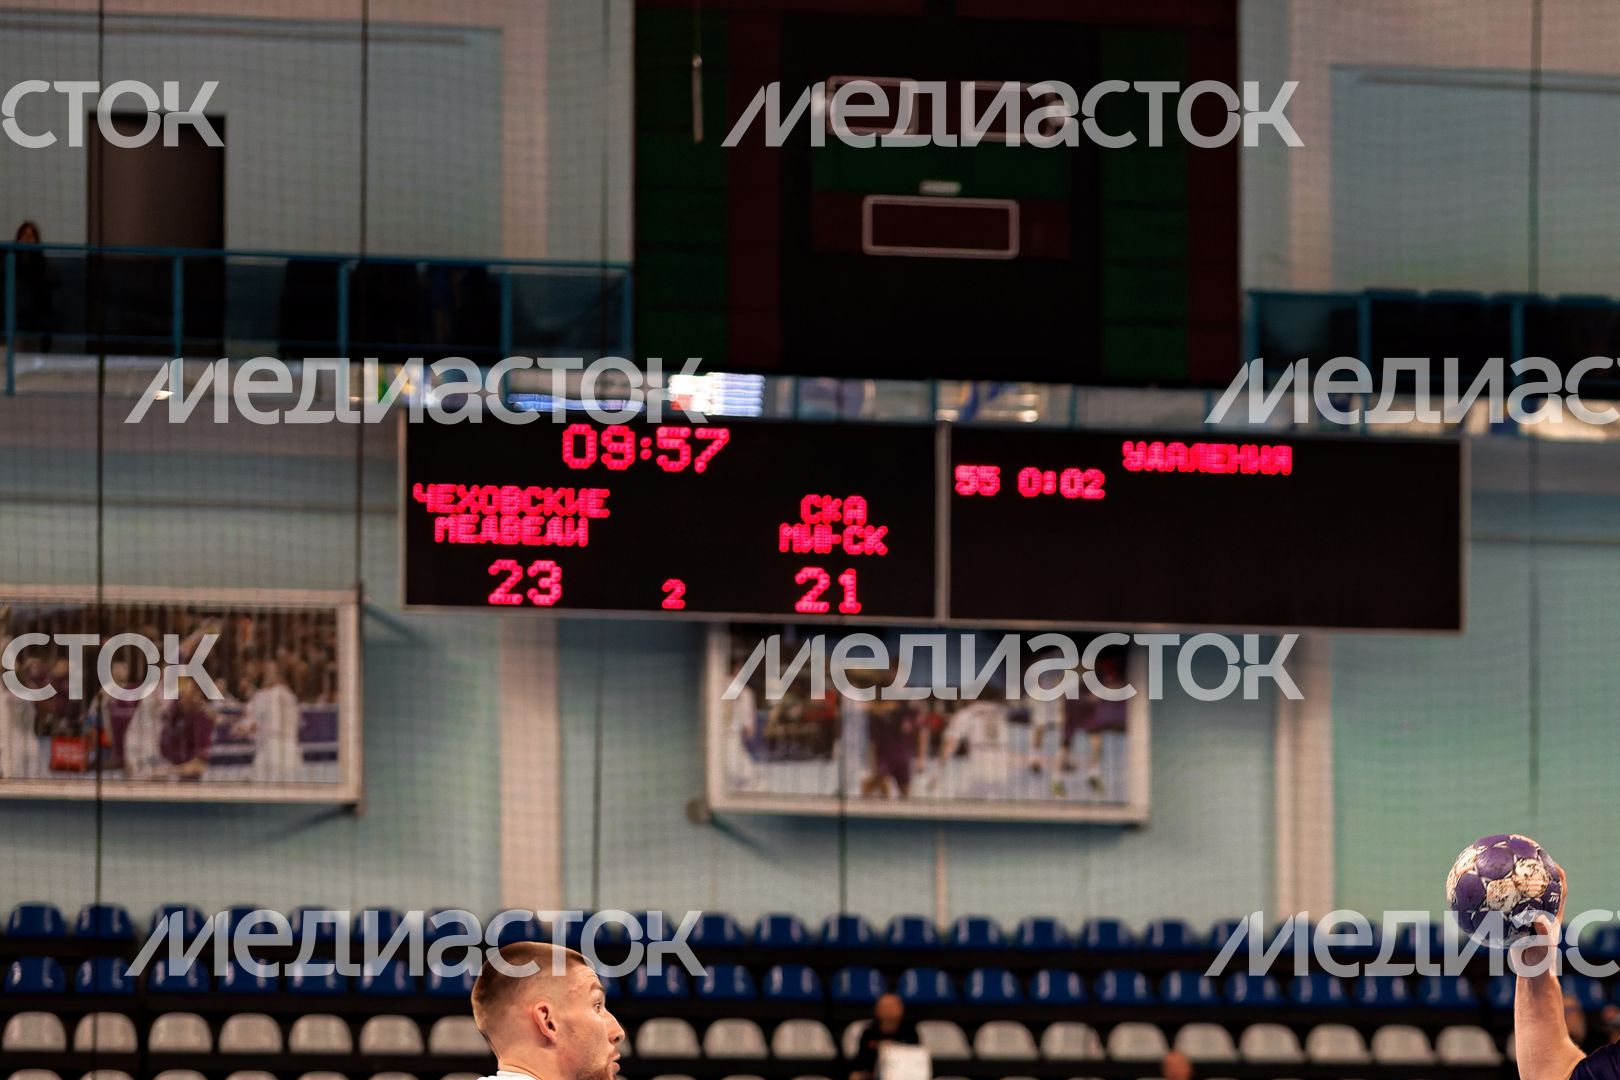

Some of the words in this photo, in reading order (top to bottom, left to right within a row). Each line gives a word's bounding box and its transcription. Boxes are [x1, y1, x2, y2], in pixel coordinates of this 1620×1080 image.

[562, 423, 730, 472] 09:57
[955, 465, 1000, 496] 55
[1018, 467, 1105, 499] 0:02
[412, 483, 610, 518] ЧЕХОВСКИЕ
[801, 494, 867, 526] СКА
[434, 514, 589, 547] МЕДВЕДИ
[488, 559, 562, 606] 23
[661, 579, 686, 609] 2
[795, 567, 862, 614] 21
